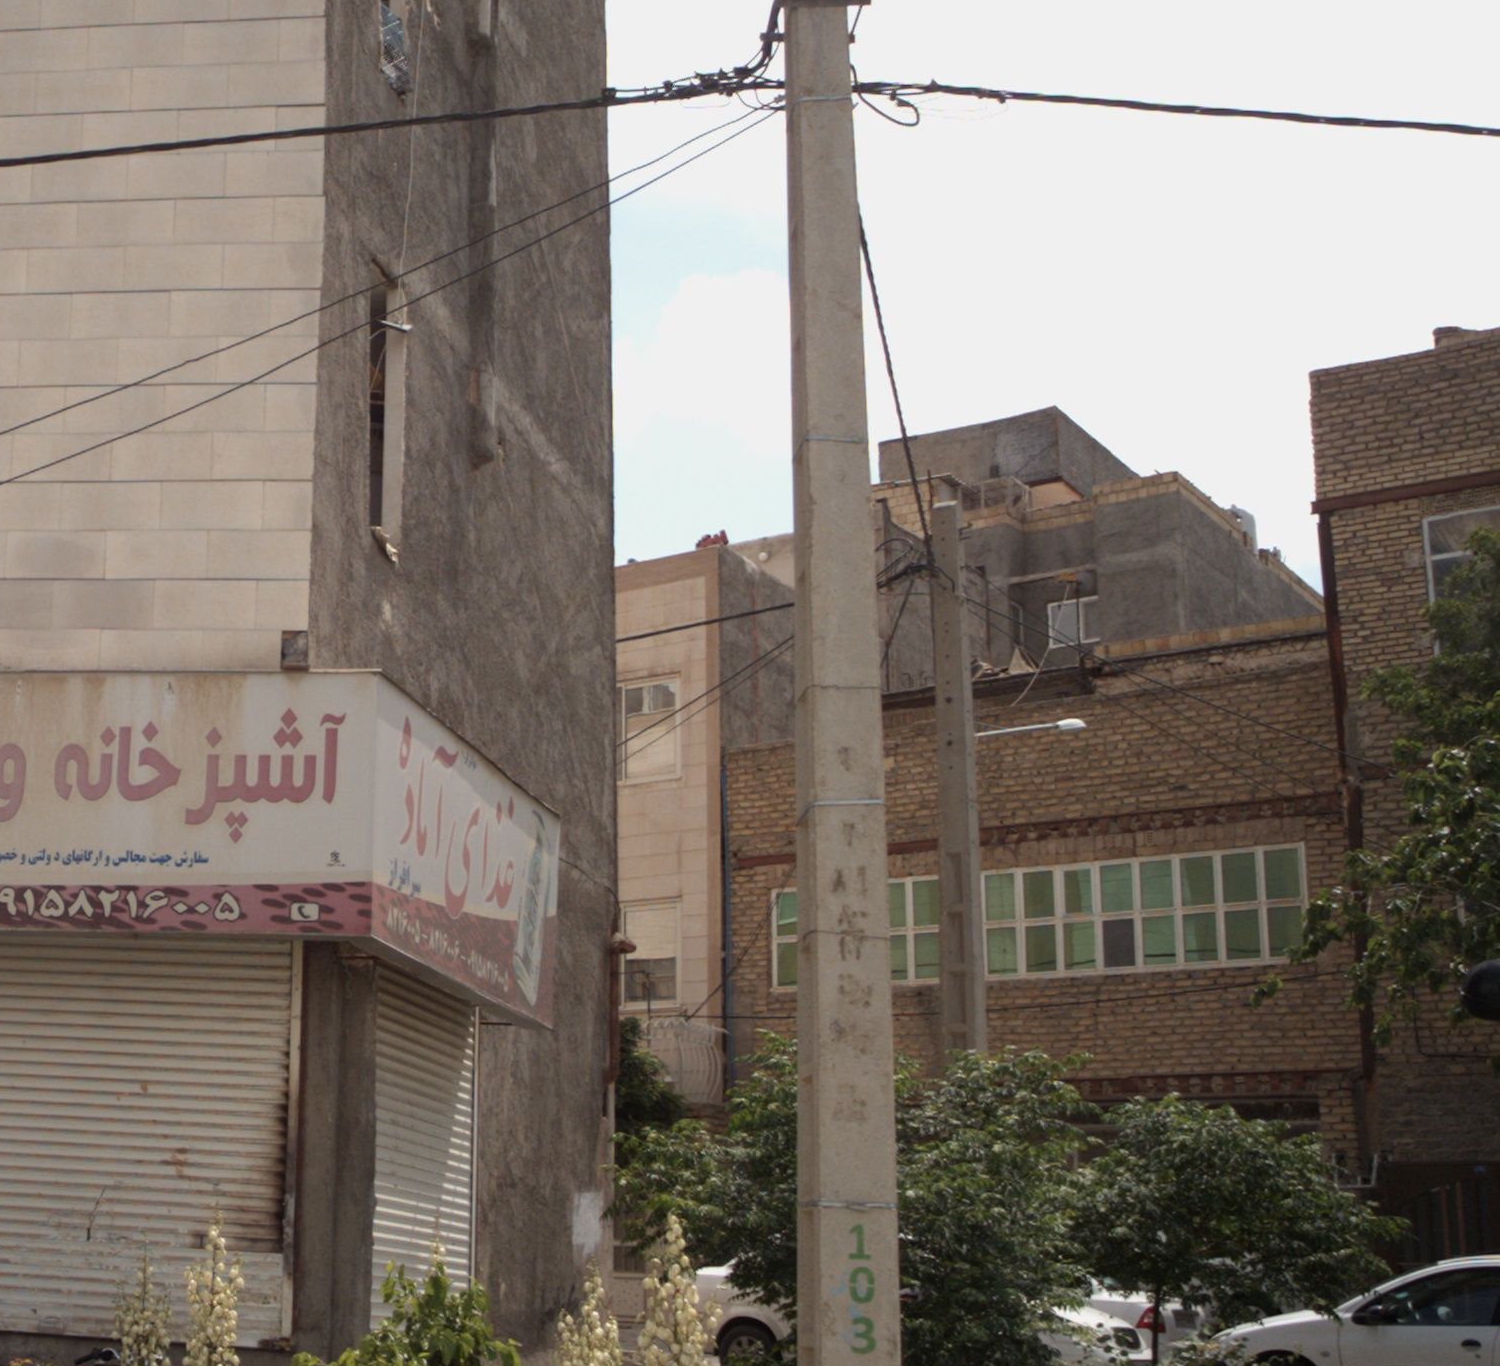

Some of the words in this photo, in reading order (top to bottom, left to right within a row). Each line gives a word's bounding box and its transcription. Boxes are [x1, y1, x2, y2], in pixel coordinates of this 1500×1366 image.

[398, 714, 459, 860] آماده
[19, 853, 26, 866] و
[104, 854, 111, 867] و
[112, 849, 147, 868] مجالس
[149, 852, 173, 868] جهت
[175, 850, 210, 868] سفارش
[443, 795, 515, 920] غذای
[848, 1222, 877, 1355] 103
